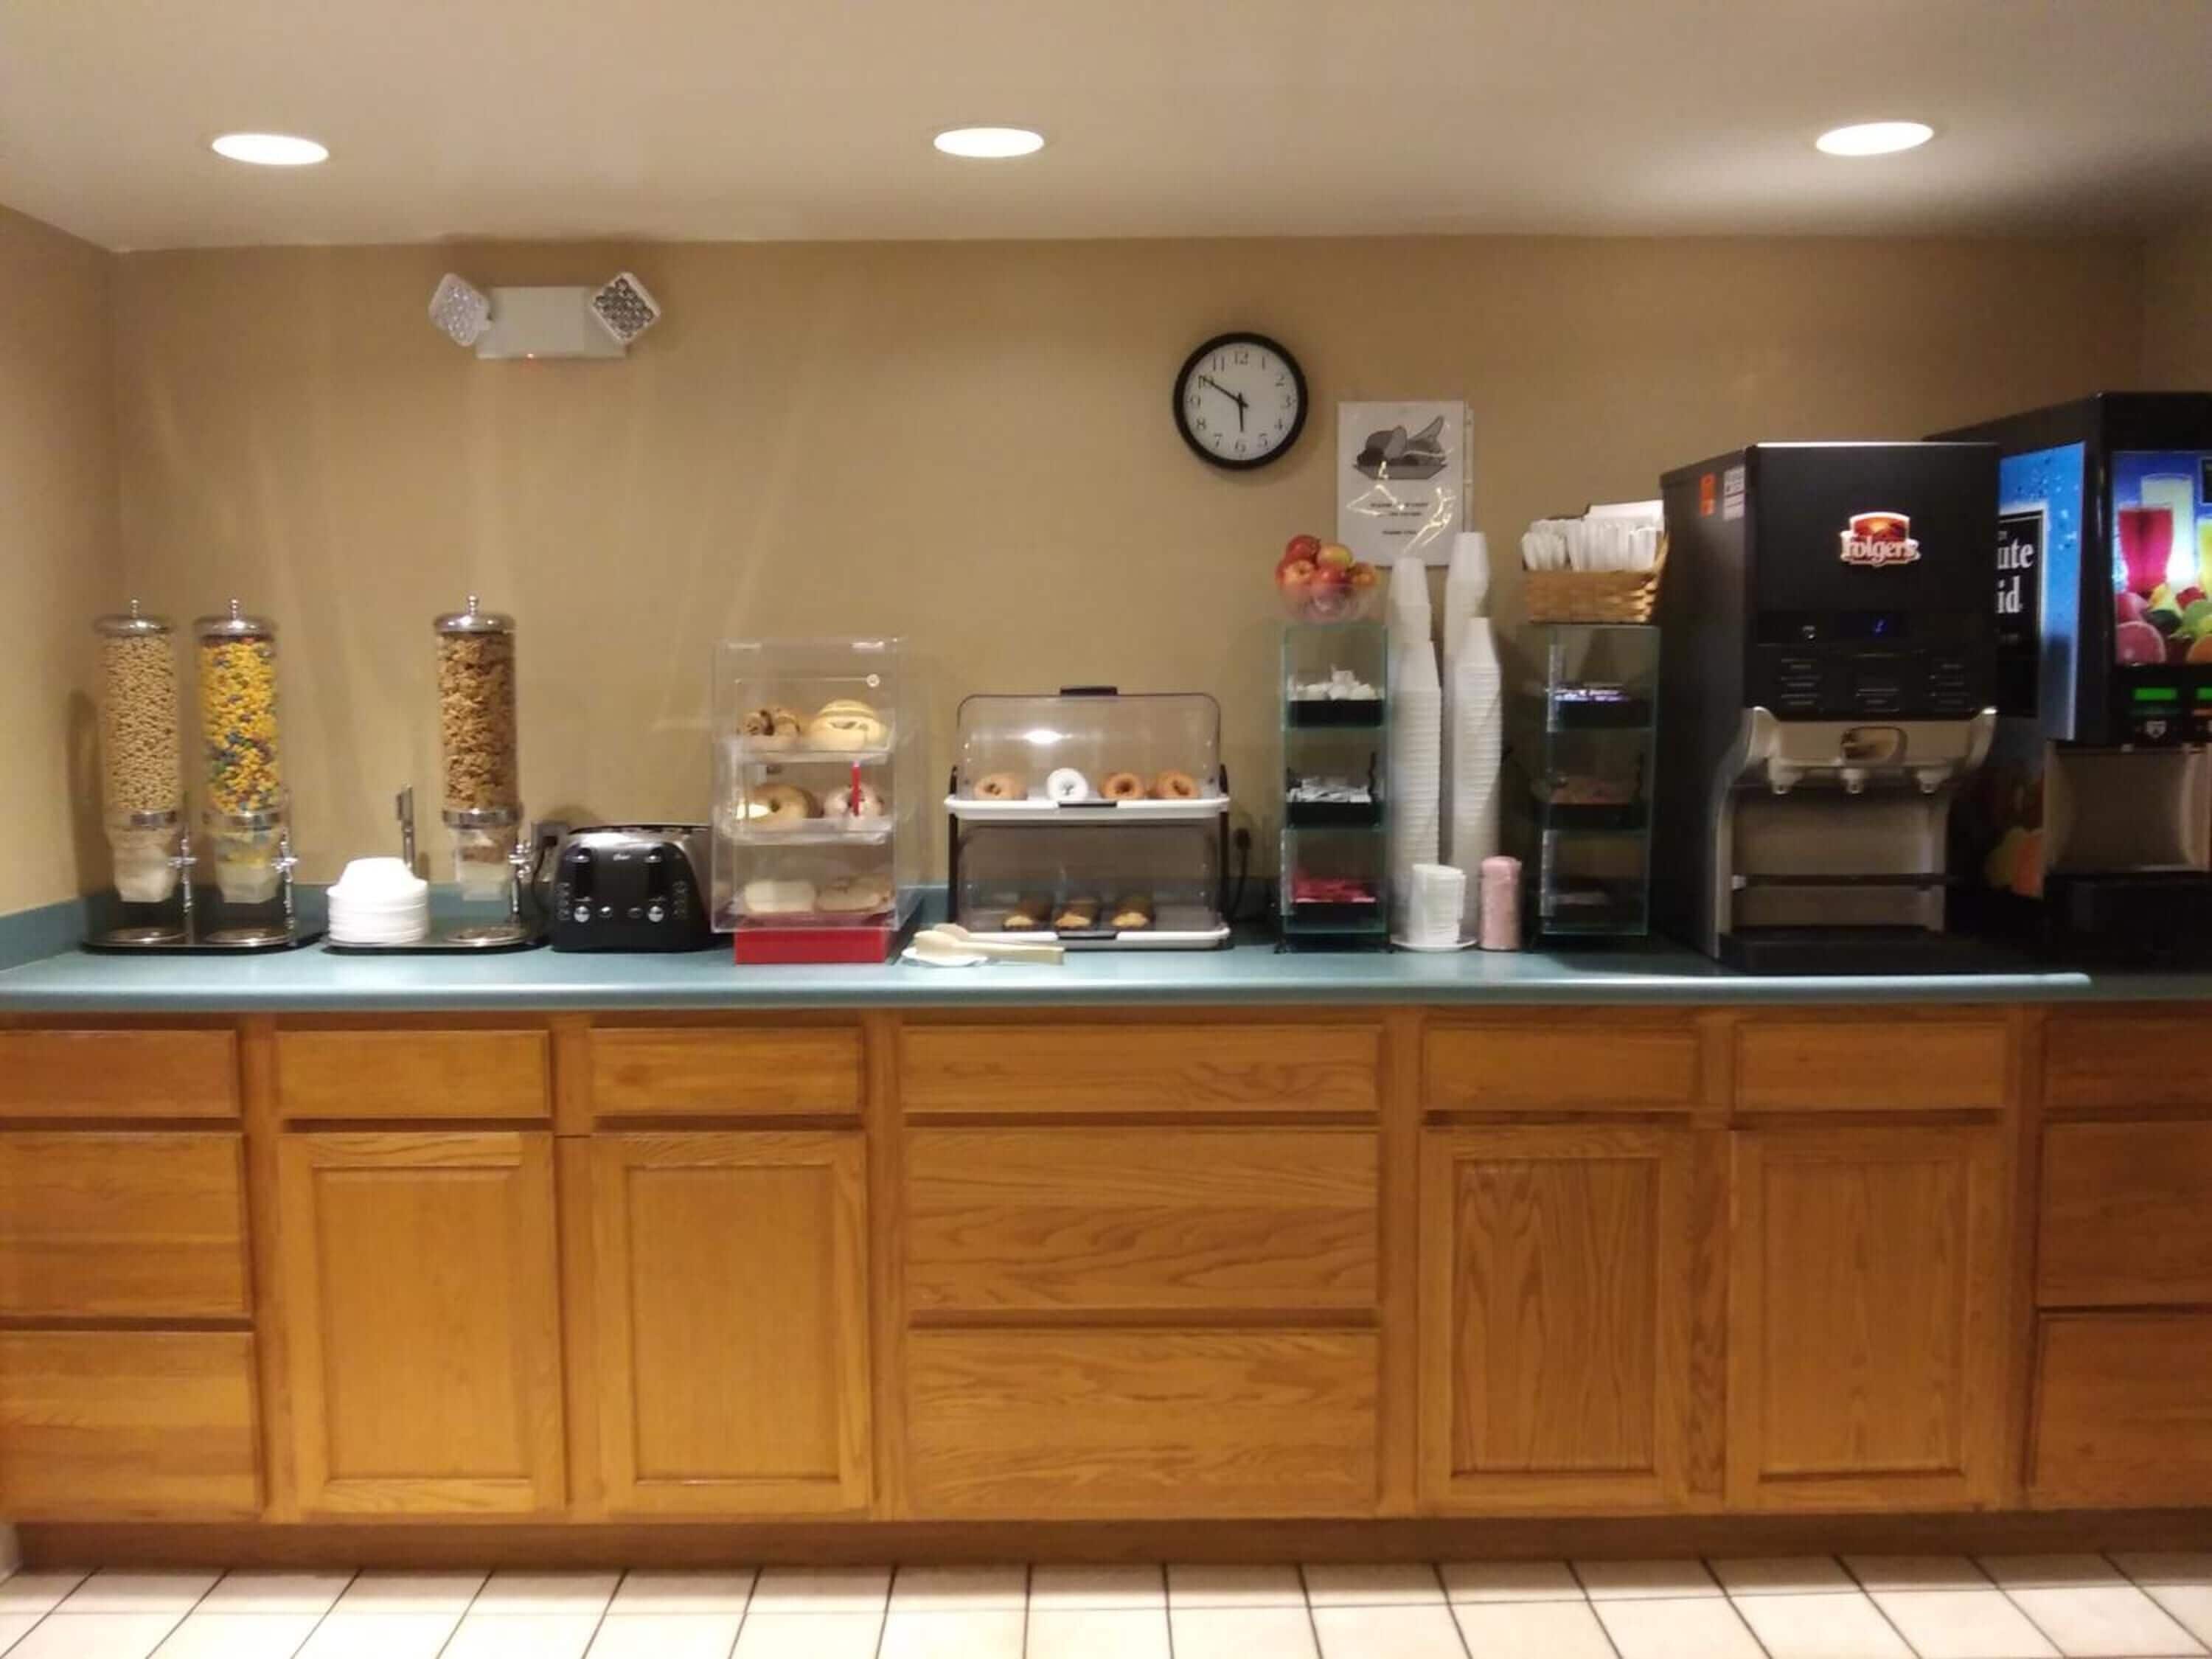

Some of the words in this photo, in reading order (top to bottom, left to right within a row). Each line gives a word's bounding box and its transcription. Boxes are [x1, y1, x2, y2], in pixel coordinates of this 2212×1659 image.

[1213, 354, 1225, 372] 11
[1234, 349, 1249, 366] 12
[1275, 373, 1285, 387] 2
[1196, 418, 1206, 431] 8
[1273, 417, 1284, 431] 4
[1213, 433, 1223, 448] 7
[1234, 439, 1247, 453] 6
[1840, 530, 1921, 566] Folgers
